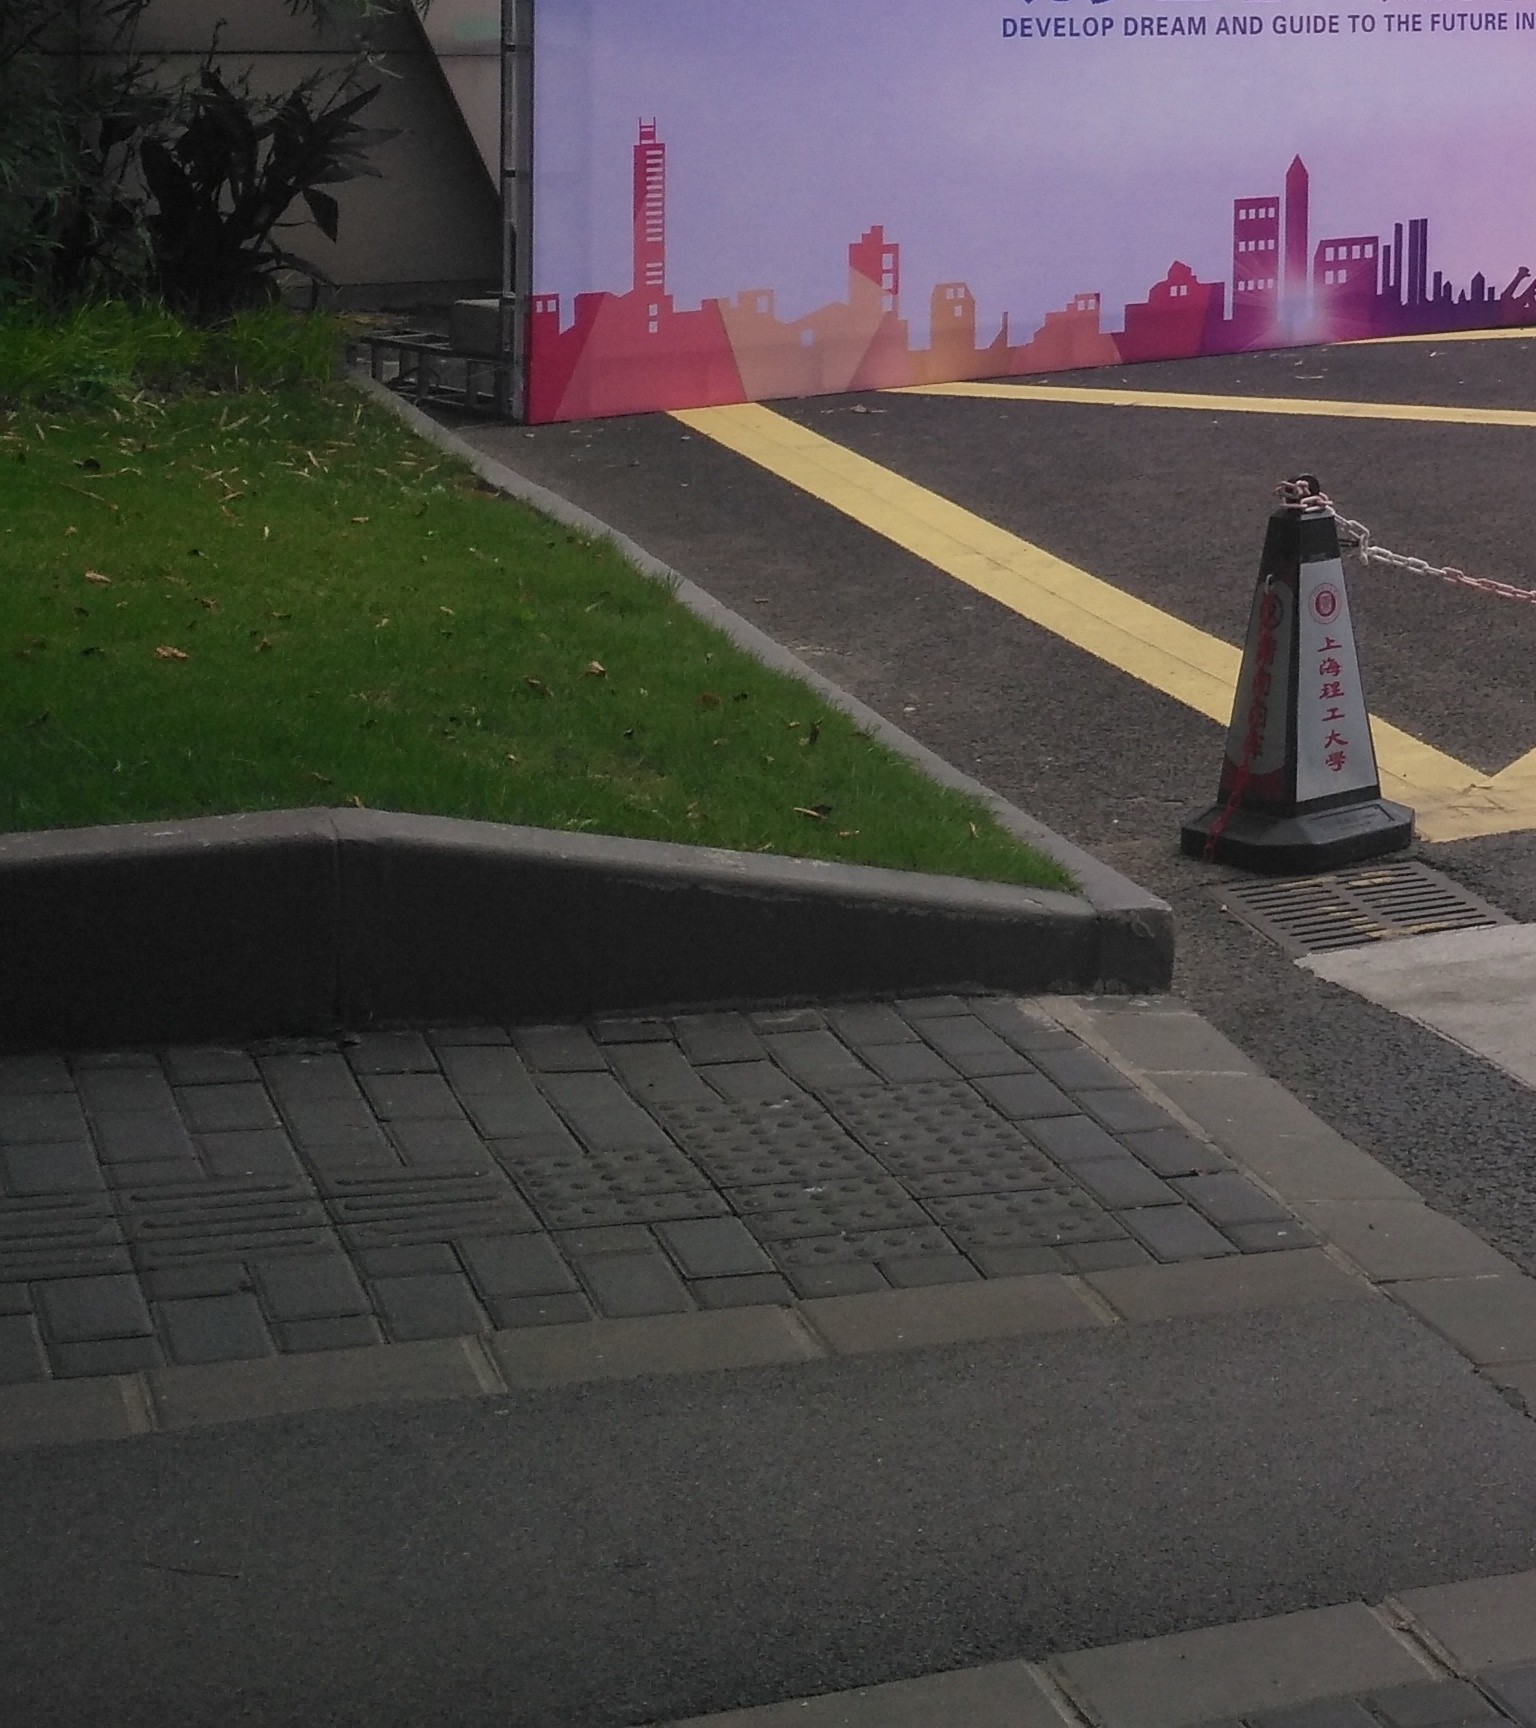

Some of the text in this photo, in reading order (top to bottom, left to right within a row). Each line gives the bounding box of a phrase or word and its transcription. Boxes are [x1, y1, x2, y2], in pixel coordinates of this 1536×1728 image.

[1002, 17, 1114, 38] DEVELOP
[1124, 16, 1206, 37] DREAM
[1216, 15, 1263, 35] AND
[1273, 15, 1339, 34] GUIDE
[1348, 14, 1376, 33] TO
[1384, 13, 1422, 32] THE
[1431, 12, 1508, 31] FUTURE
[1516, 12, 1535, 30] IN
